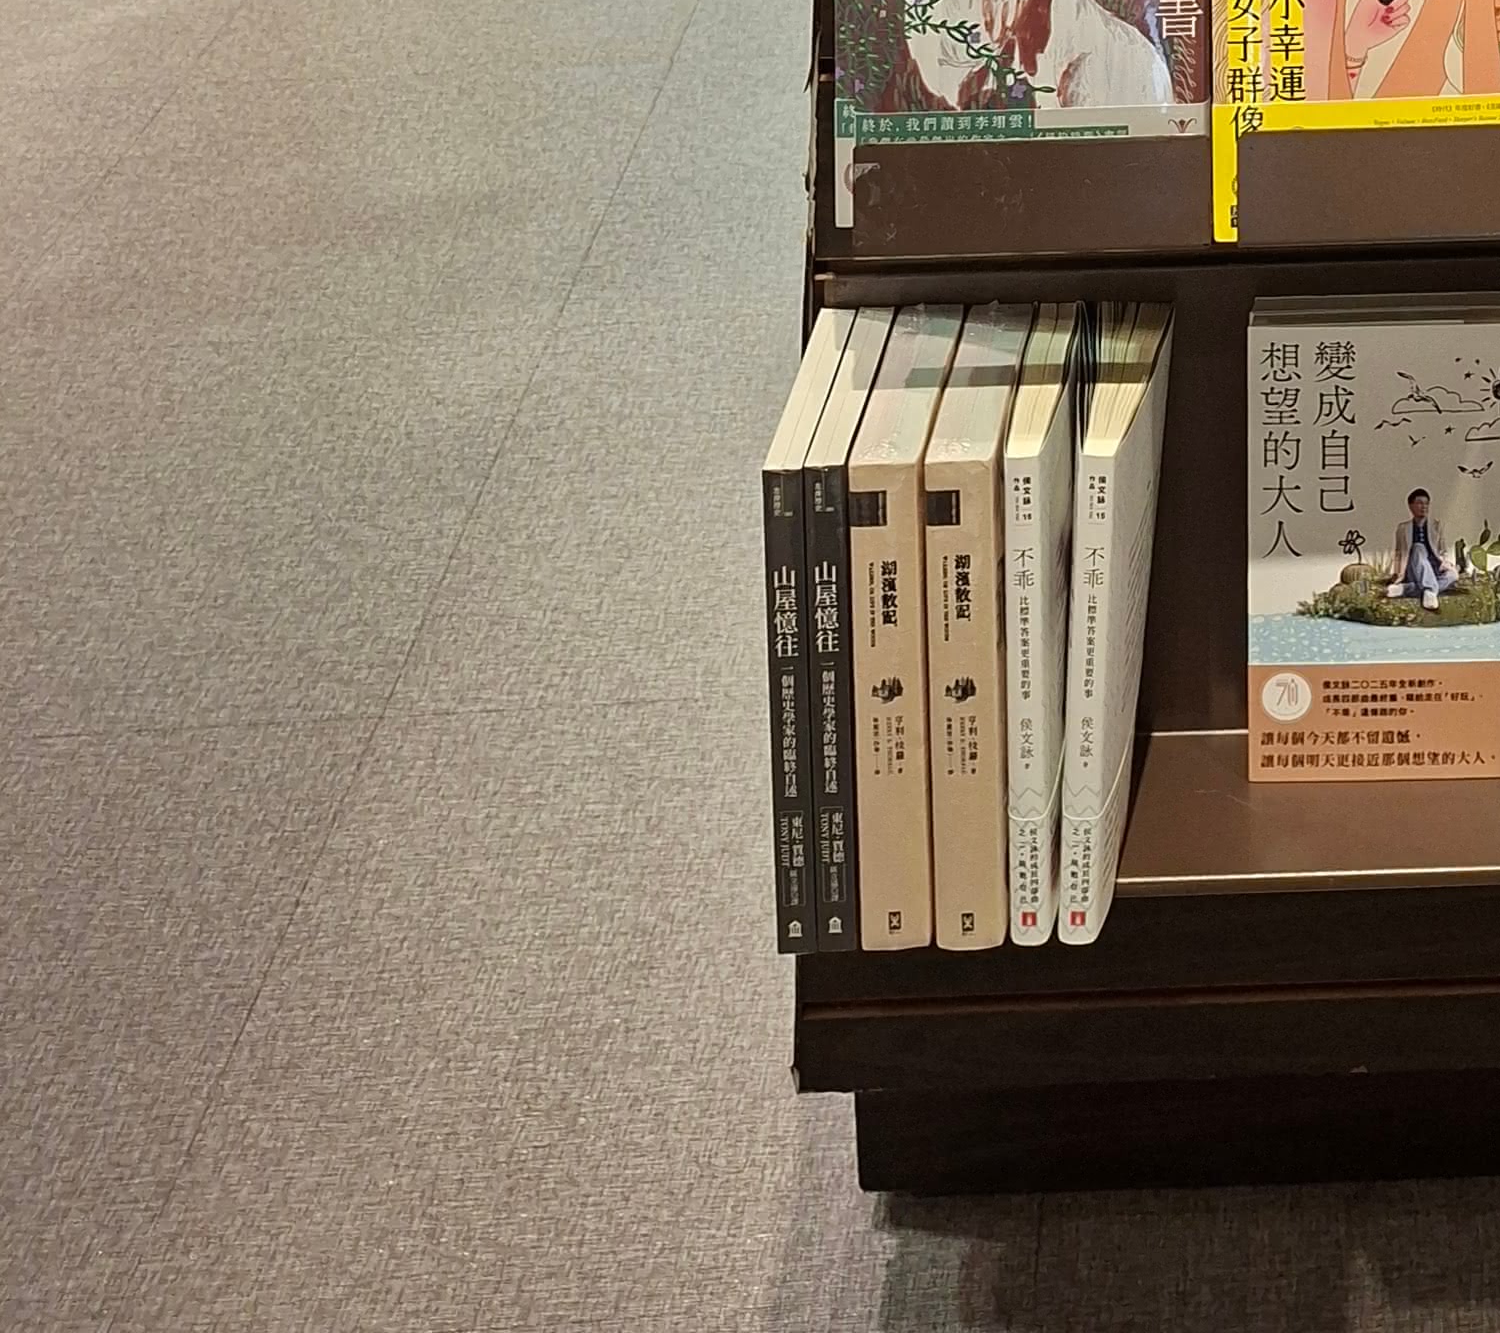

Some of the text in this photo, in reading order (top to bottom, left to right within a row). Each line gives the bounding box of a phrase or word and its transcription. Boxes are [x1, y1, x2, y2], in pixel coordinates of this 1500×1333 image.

[1261, 341, 1303, 560] 想望的大人
[1313, 341, 1356, 514] 變成自己
[773, 565, 799, 658] 山屋憶往
[814, 561, 840, 653] 山屋憶往
[1013, 547, 1035, 590] 不乖
[1083, 546, 1105, 589] 不乖
[1019, 595, 1031, 700] 比標準答案更重要的事
[1083, 593, 1097, 699] 比標準答案更重要的事
[1020, 717, 1034, 759] 侯文詠
[1080, 716, 1093, 758] 侯文詠
